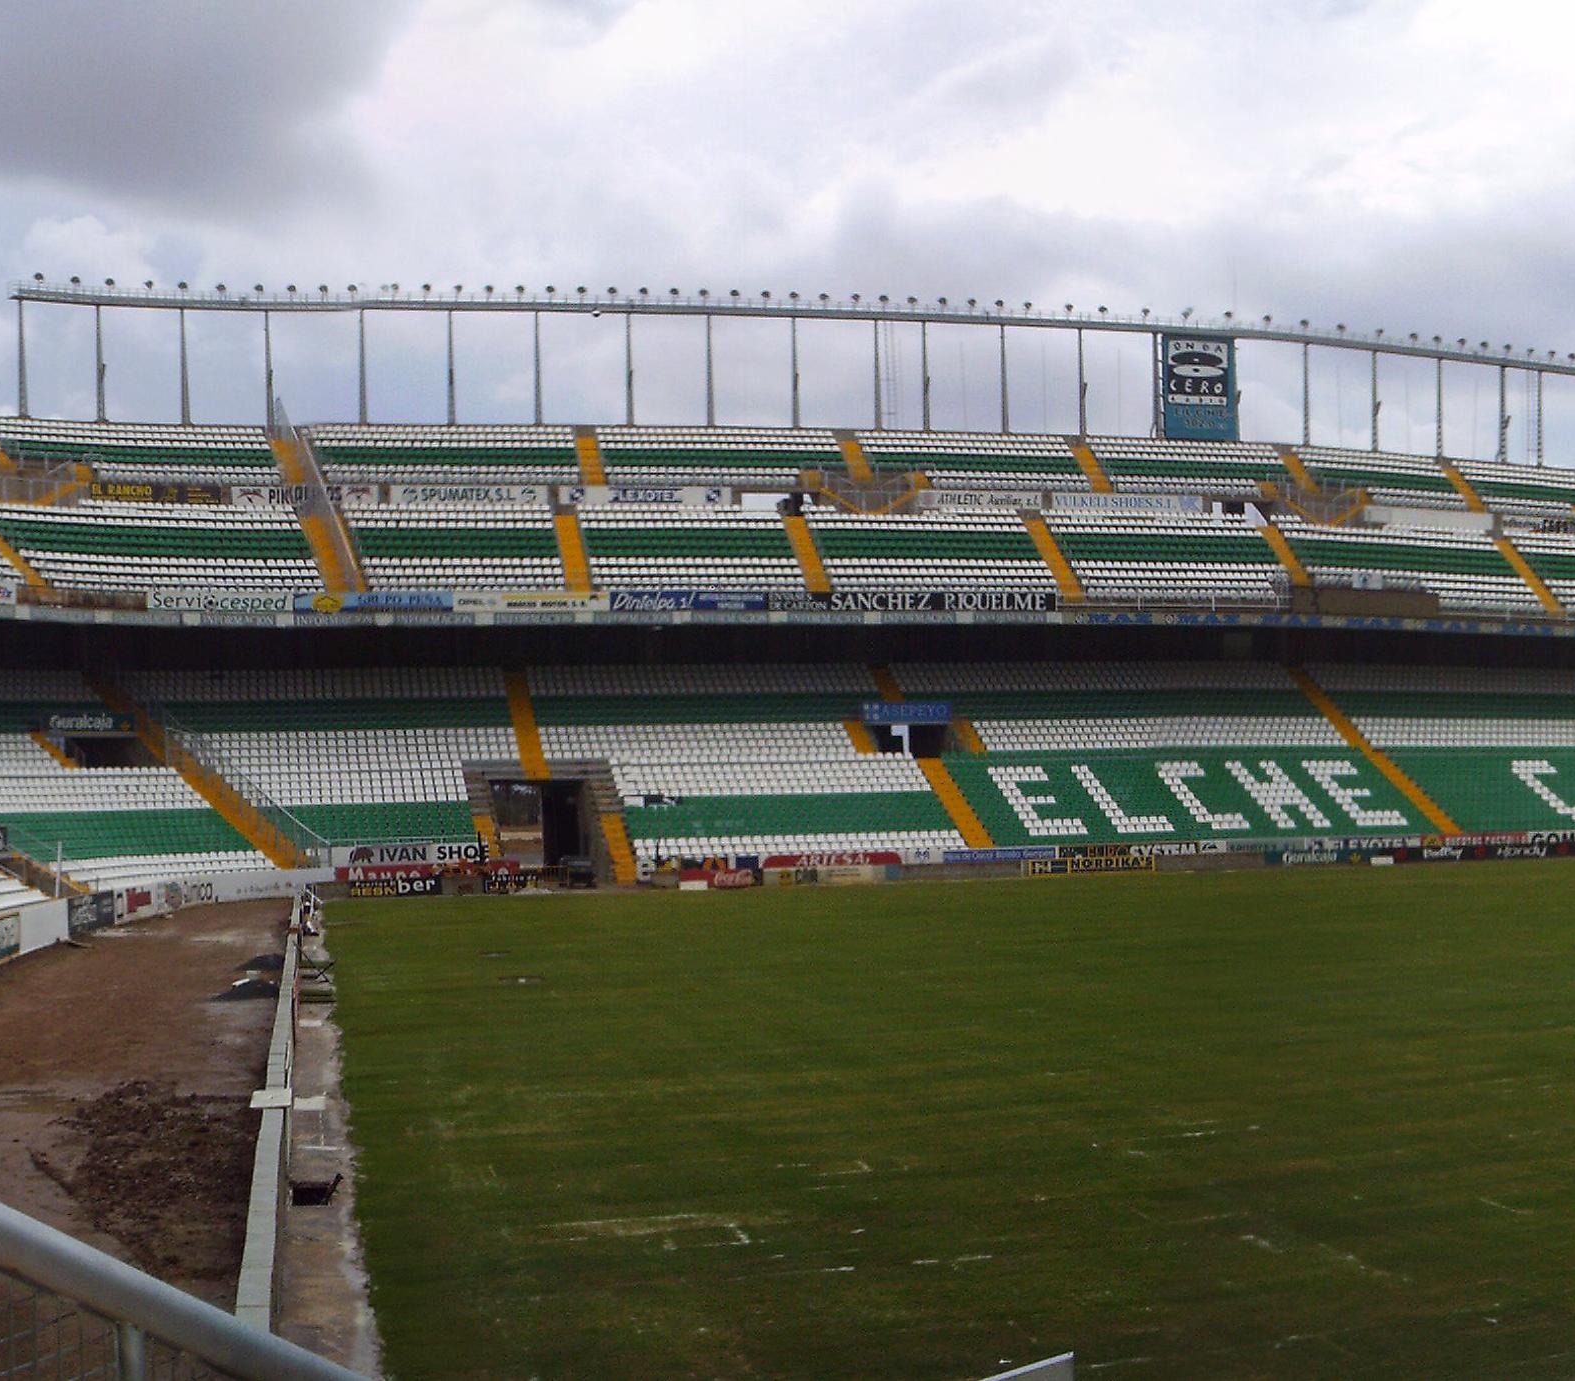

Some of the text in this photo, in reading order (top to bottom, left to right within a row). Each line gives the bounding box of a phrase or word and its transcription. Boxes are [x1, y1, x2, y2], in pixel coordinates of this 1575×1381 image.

[1169, 379, 1224, 394] CERO
[830, 591, 1046, 611] SANCHEZ RIQUELME
[987, 759, 1408, 838] ELCHE
[379, 847, 428, 863] IVAN
